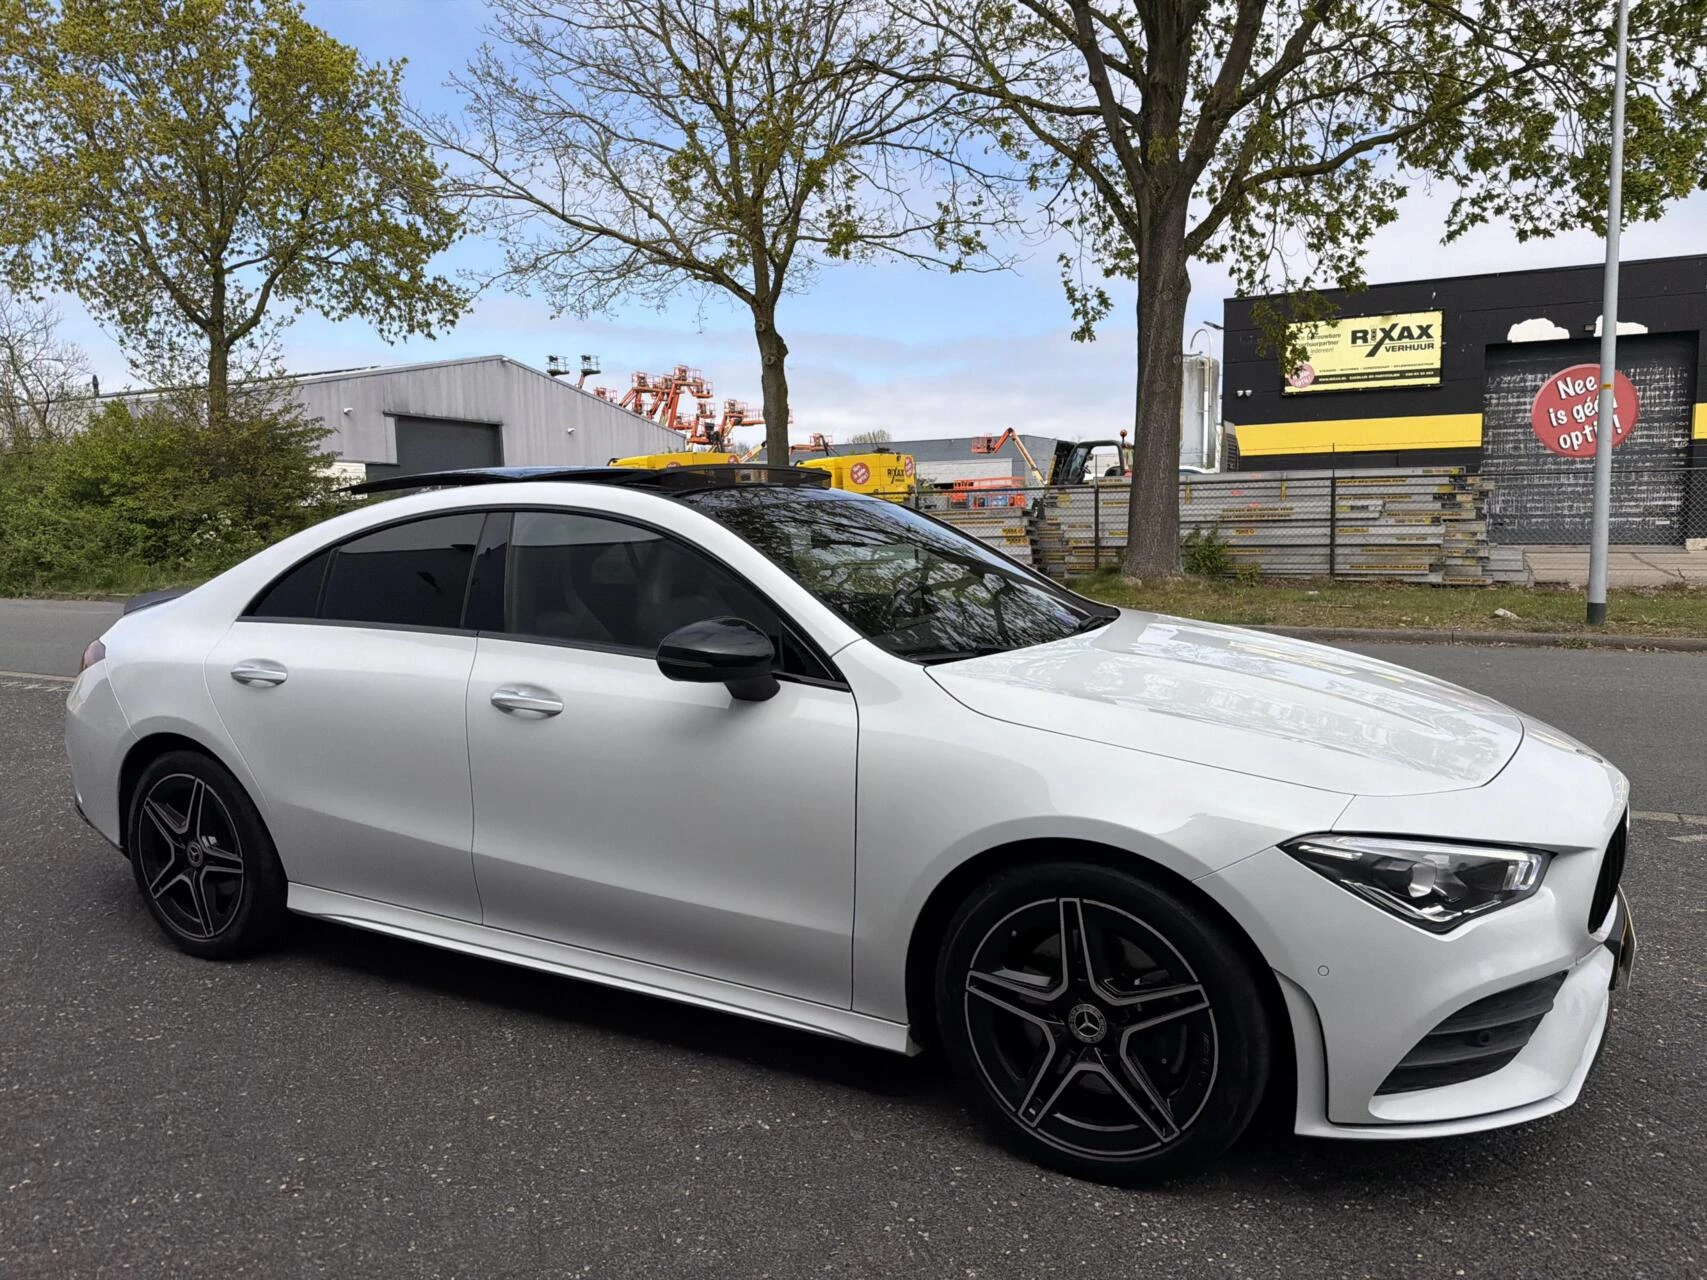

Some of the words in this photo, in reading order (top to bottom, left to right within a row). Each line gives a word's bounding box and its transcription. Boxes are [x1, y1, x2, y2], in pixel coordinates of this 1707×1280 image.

[1384, 342, 1435, 353] VERHUUR
[1556, 376, 1598, 400] Nee
[1548, 407, 1568, 427] is
[1558, 414, 1623, 451] opti!
